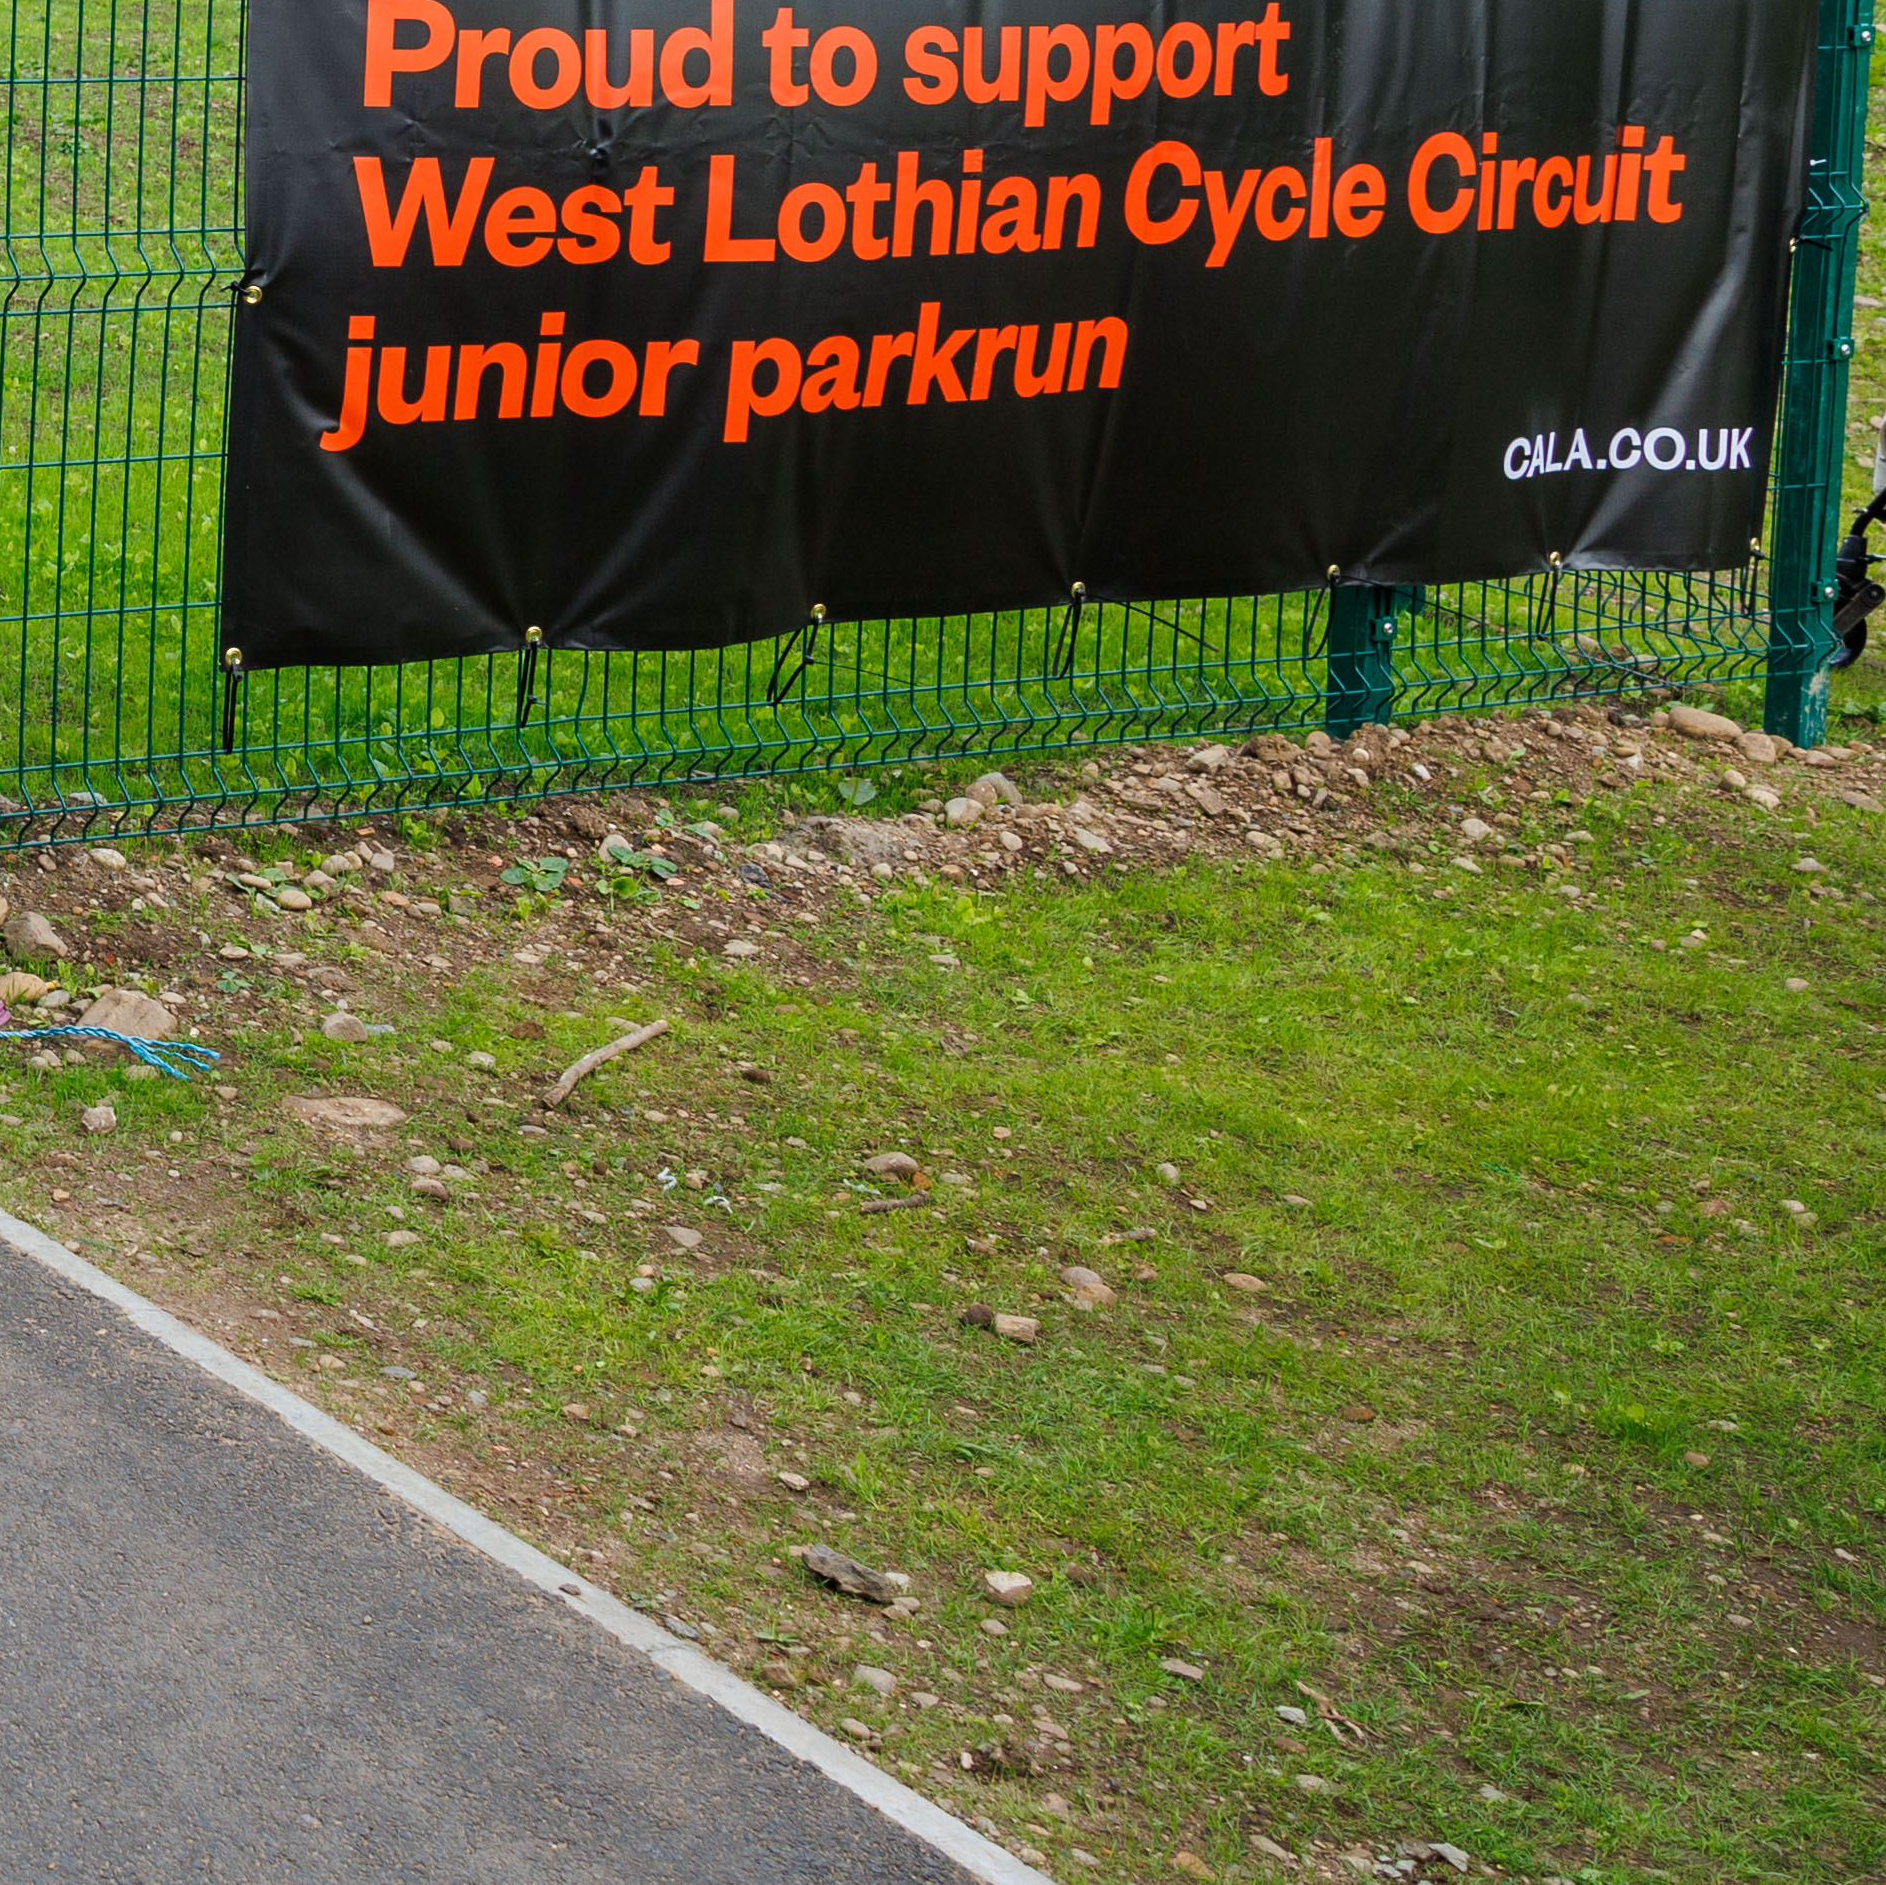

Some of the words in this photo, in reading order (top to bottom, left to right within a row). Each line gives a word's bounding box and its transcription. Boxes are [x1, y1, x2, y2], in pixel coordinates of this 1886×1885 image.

[761, 7, 878, 108] to
[902, 2, 1291, 128] support
[352, 155, 675, 268] West
[703, 148, 1102, 263] Lothian
[1124, 136, 1387, 268] Cycle
[1407, 125, 1686, 235] Circuit
[319, 311, 700, 452] junior
[723, 301, 1128, 443] parkrun
[1503, 427, 1754, 480] CALA.CO.UK
